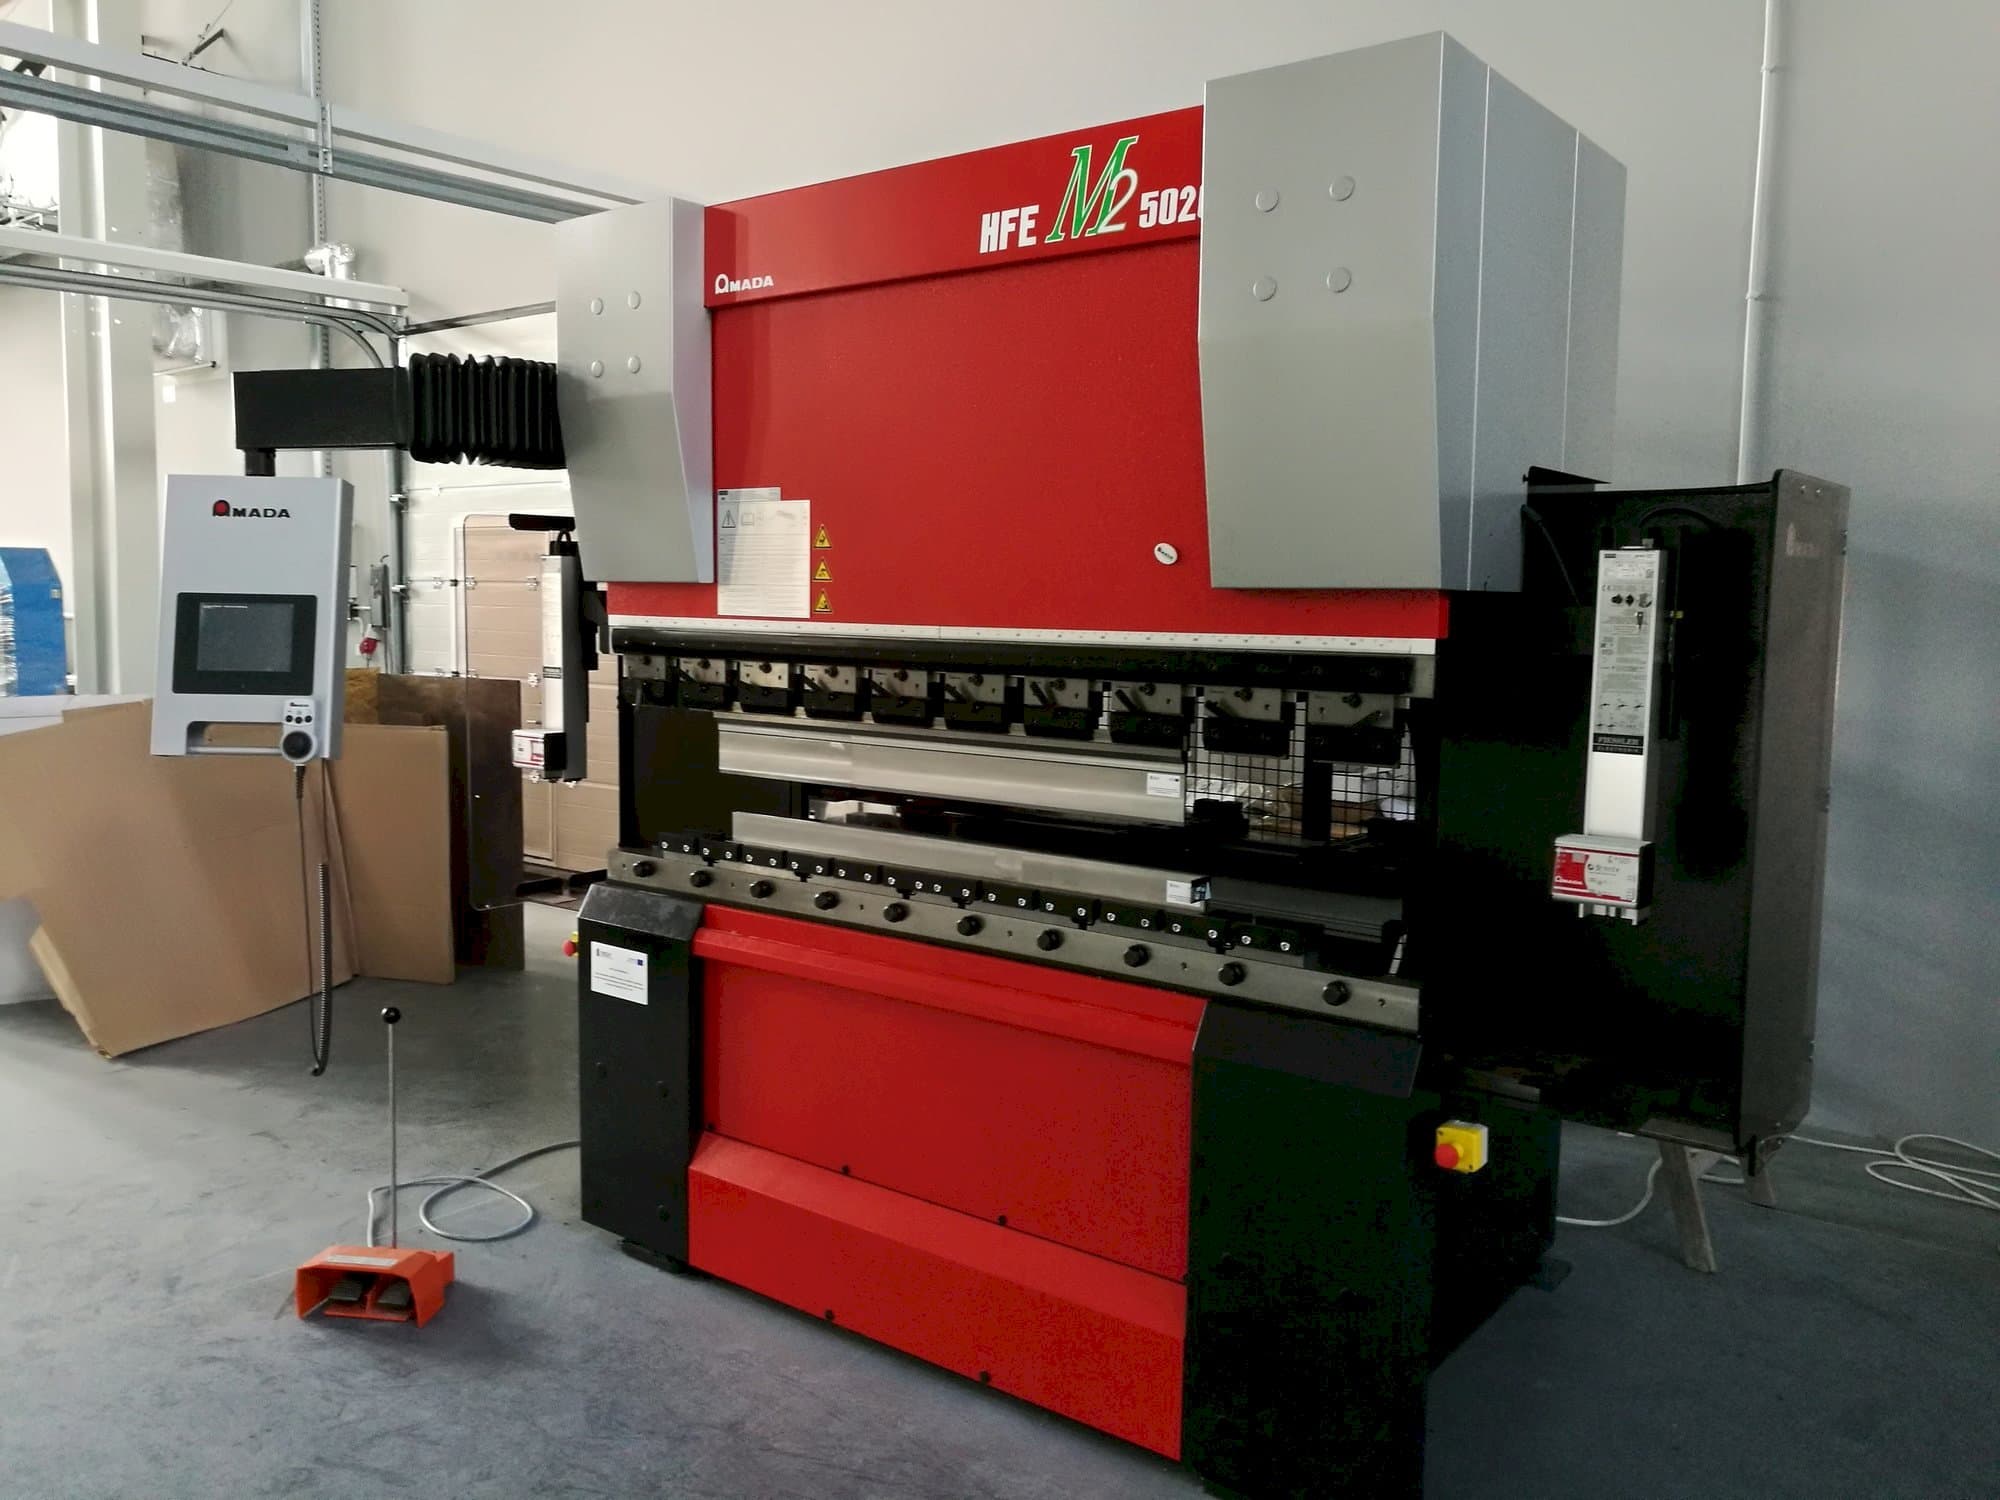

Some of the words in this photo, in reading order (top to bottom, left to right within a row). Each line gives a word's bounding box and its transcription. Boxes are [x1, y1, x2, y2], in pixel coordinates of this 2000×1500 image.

[979, 204, 1040, 254] HFE
[1044, 135, 1140, 244] M2
[1138, 184, 1203, 228] 502
[714, 273, 775, 295] AMADA
[212, 499, 291, 519] AMADA
